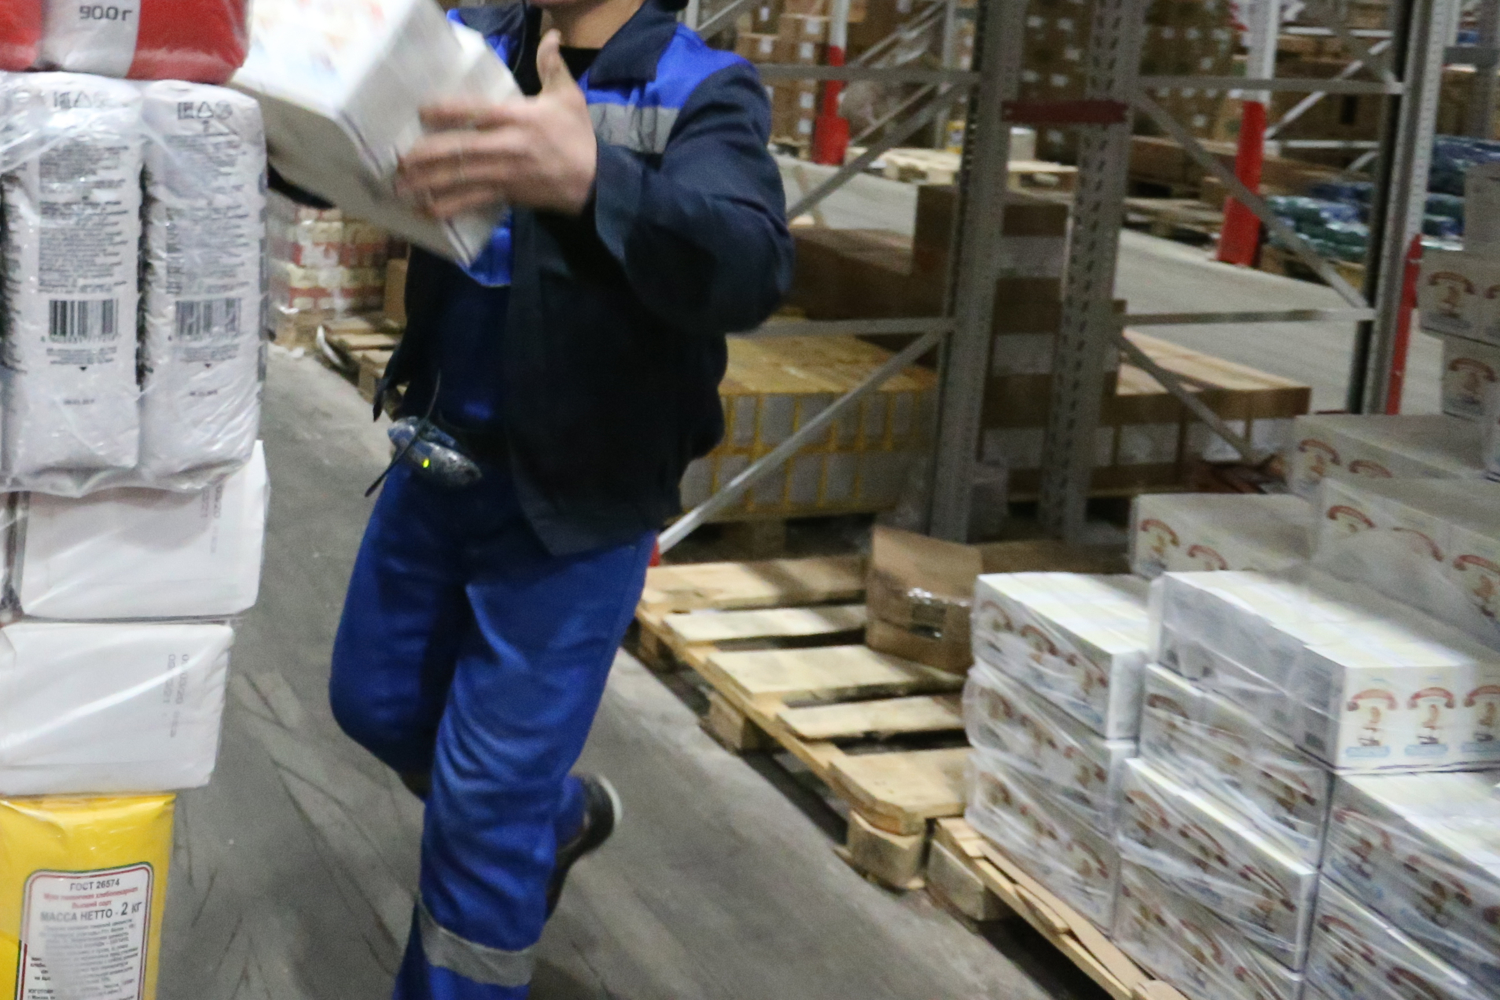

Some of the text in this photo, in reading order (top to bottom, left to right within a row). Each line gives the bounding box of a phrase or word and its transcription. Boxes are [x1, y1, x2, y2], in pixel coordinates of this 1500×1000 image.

[70, 879, 120, 891] ГОСТ 26574
[41, 911, 77, 920] МАССА
[81, 909, 113, 920] НЕТТО
[121, 902, 129, 916] 2
